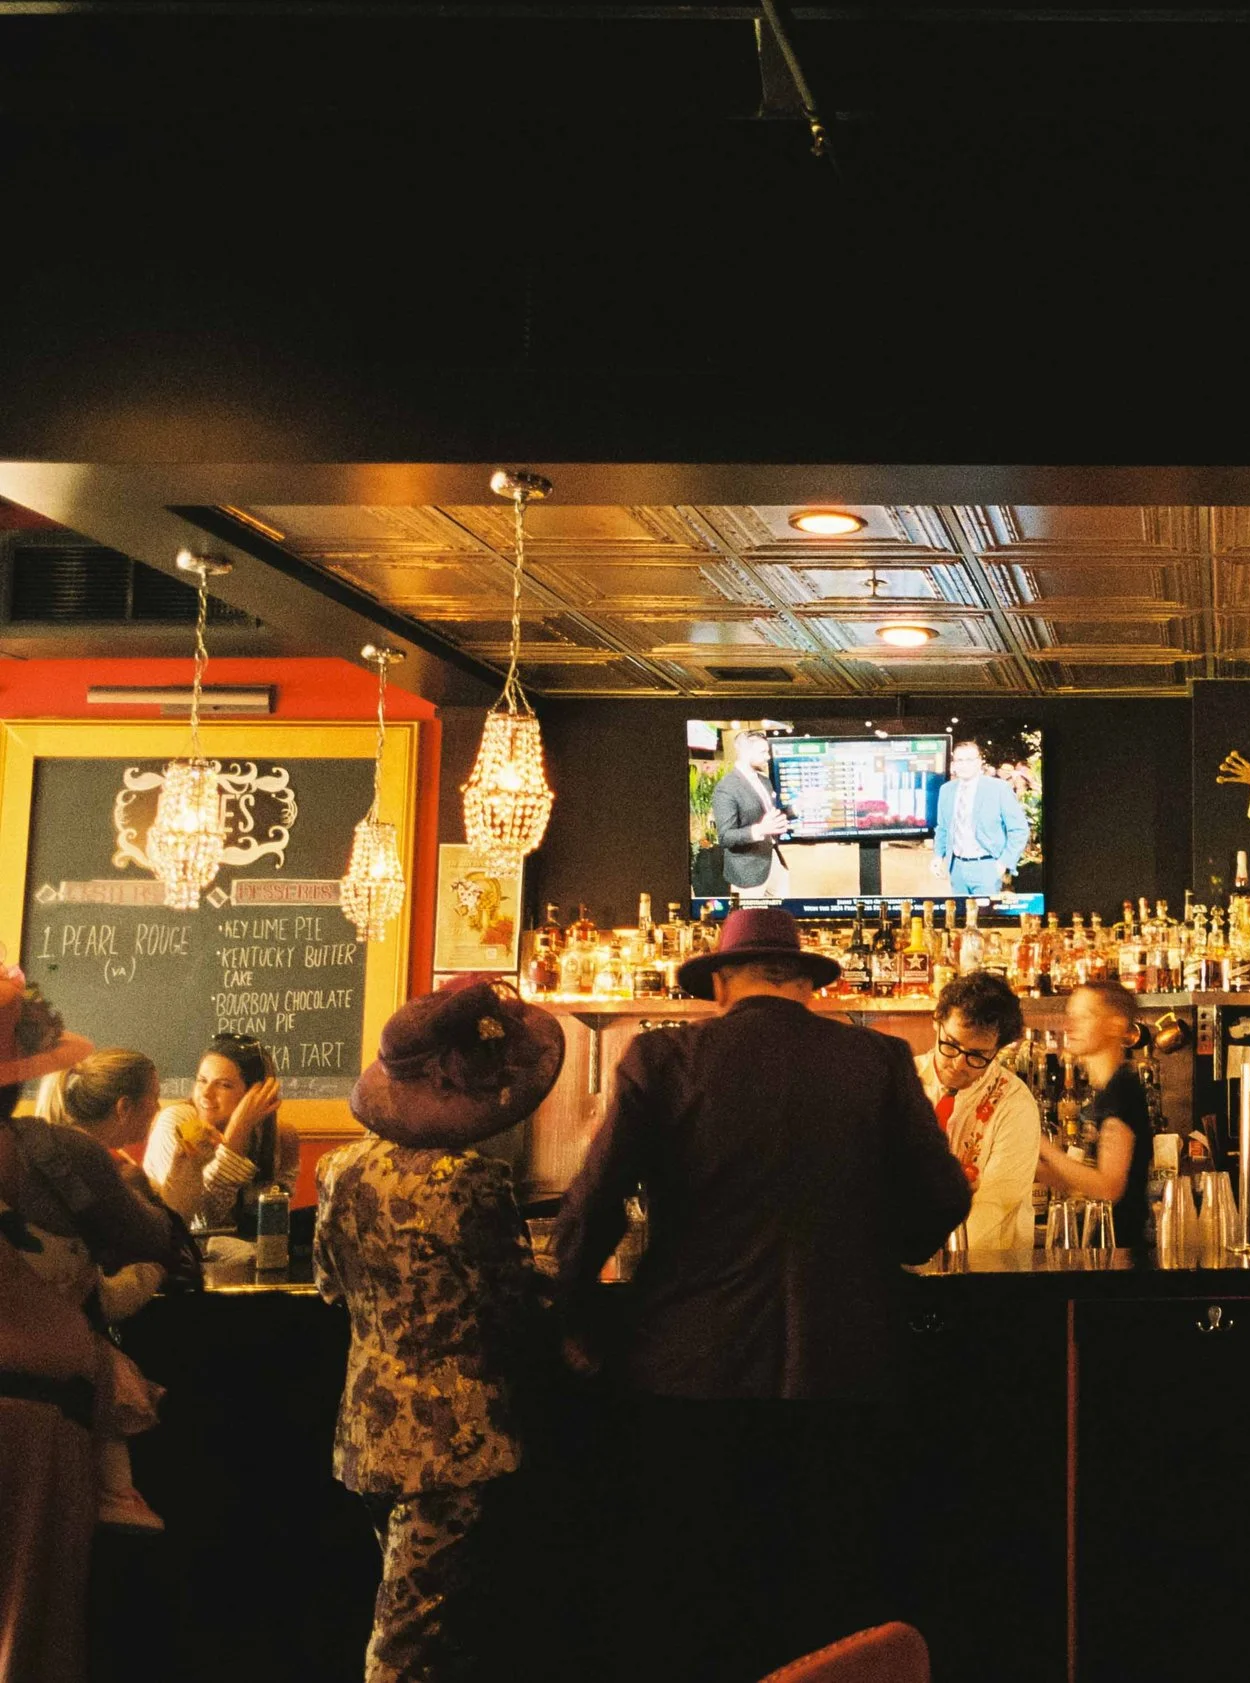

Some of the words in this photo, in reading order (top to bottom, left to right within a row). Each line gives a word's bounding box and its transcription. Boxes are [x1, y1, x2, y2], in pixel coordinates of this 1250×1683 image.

[37, 926, 55, 958] 1
[62, 924, 118, 957] PEARL
[135, 923, 191, 956] ROUGE
[225, 919, 249, 938] KEY
[253, 918, 289, 940] LIME
[294, 916, 324, 941] PIE
[221, 946, 296, 968] KENTUCKY
[304, 943, 357, 968] BUTTER
[104, 956, 136, 984] (VA)
[224, 970, 254, 988] CAKE
[216, 992, 280, 1017] BOURBON
[284, 989, 354, 1011] CHOCOLATE
[218, 1016, 266, 1034] PECAN
[276, 1013, 297, 1033] PIE
[300, 1041, 345, 1068] TART
